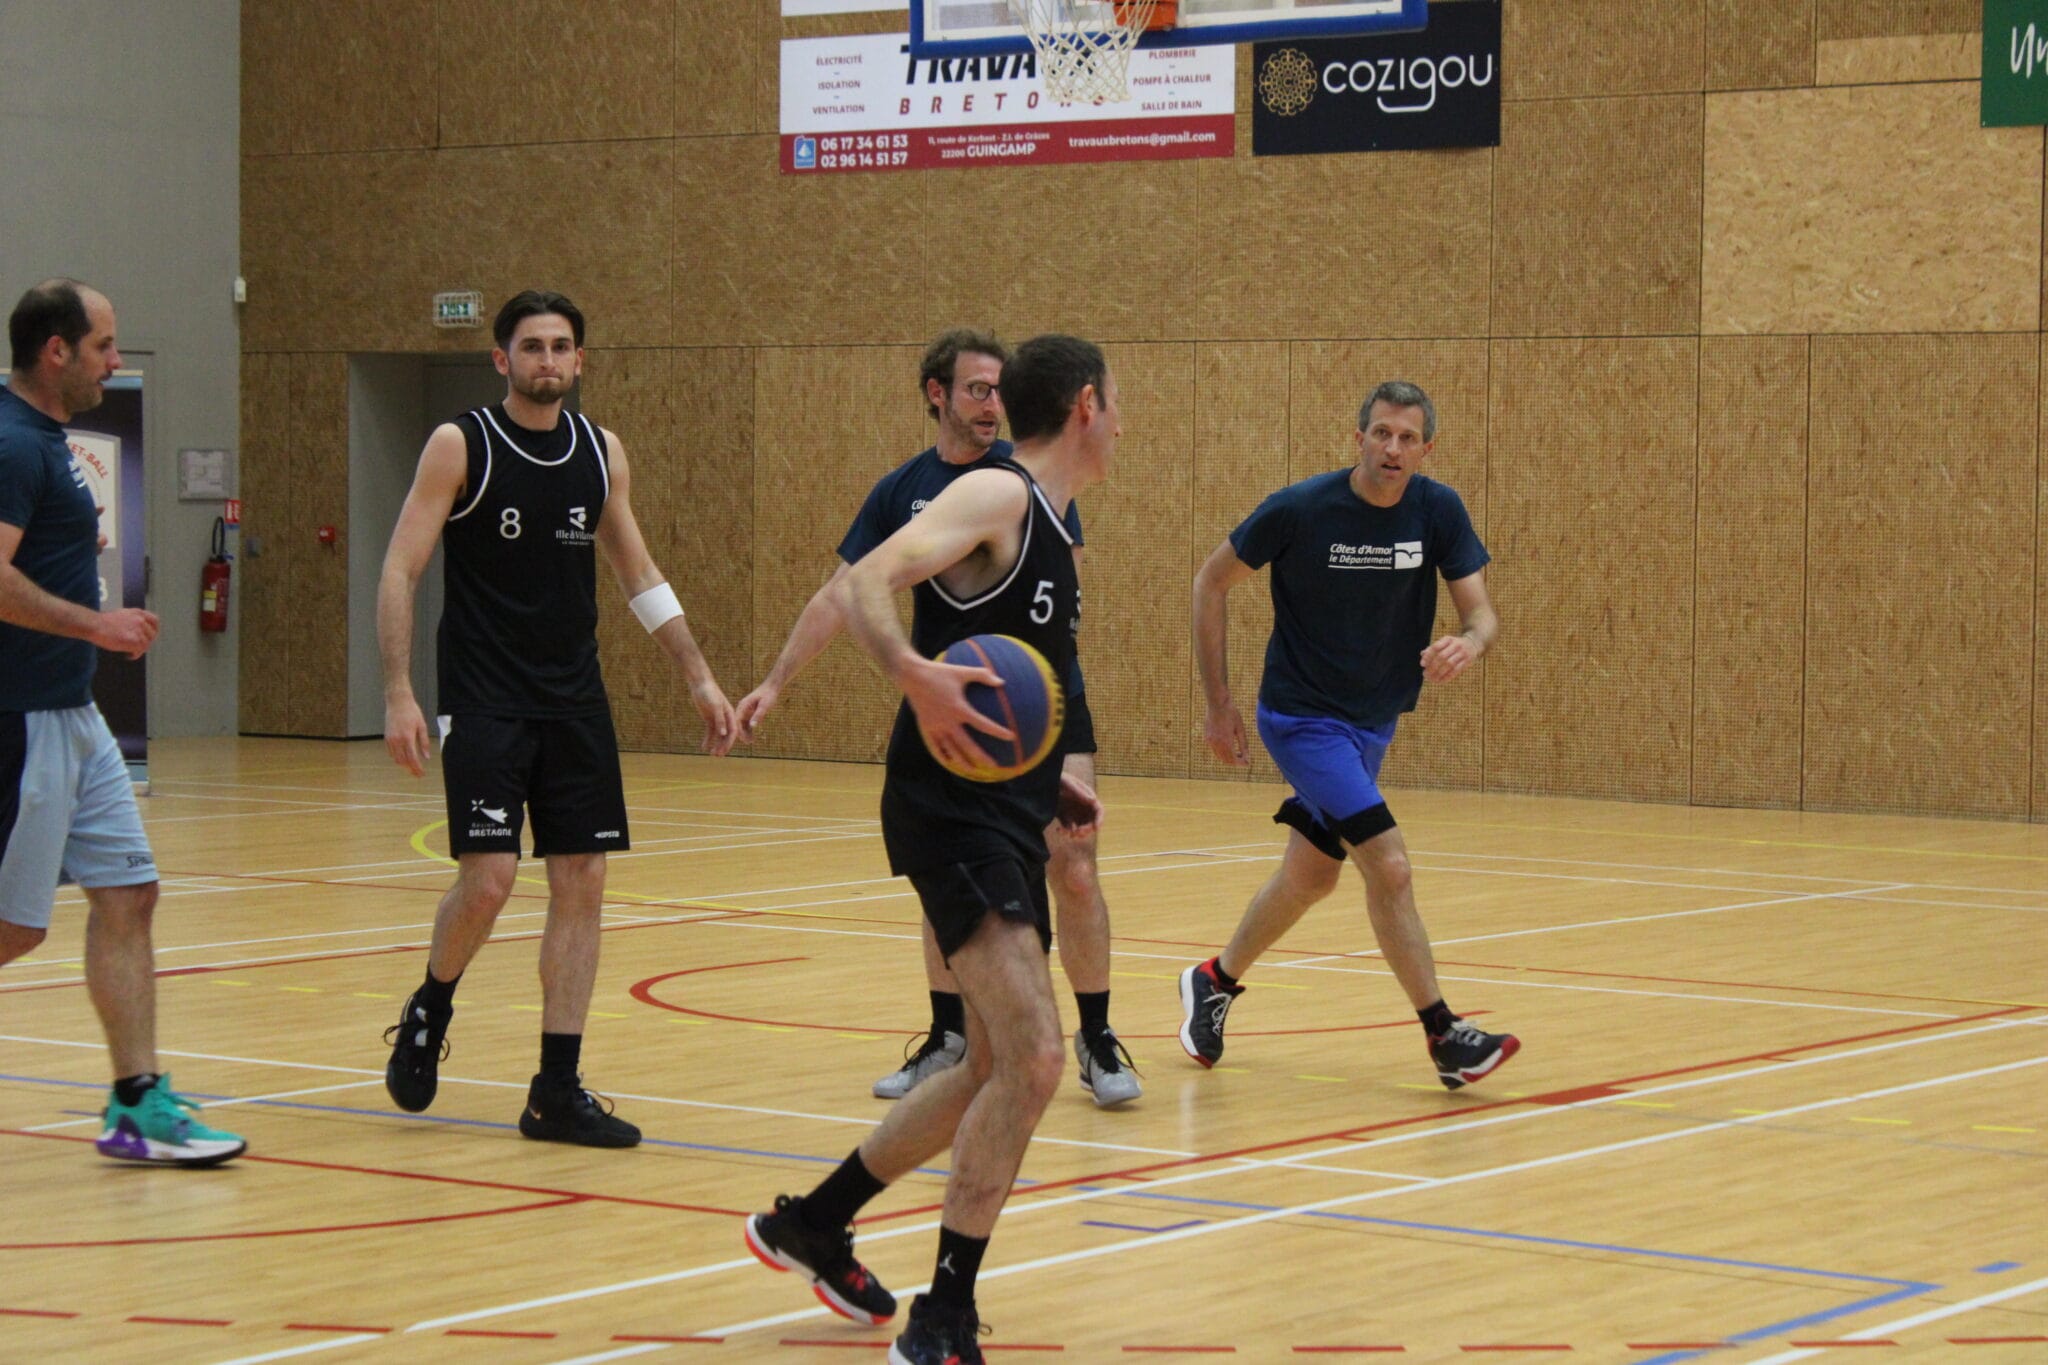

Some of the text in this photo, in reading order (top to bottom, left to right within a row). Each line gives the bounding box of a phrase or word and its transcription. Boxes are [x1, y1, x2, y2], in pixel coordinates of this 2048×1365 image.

[816, 54, 862, 66] ÉLECTRICITÉ
[1149, 49, 1196, 59] PLOMBERIE
[818, 80, 860, 90] ISOLATION
[1133, 74, 1211, 86] POMPE À CHALEUR
[899, 91, 1104, 115] BRETO
[1141, 100, 1202, 111] SALLE DE BAIN
[812, 104, 865, 115] VENTILATION
[821, 134, 908, 151] 06 17 34 61 53
[1069, 131, 1216, 147] travauxbretons@gmail.com
[967, 142, 1036, 157] GUINGAMP
[821, 151, 908, 168] 02 96 14 51 57
[500, 507, 521, 539] 8
[1330, 544, 1393, 555] Côtes d'Armor
[1329, 554, 1392, 565] le Département
[1030, 580, 1053, 624] 5
